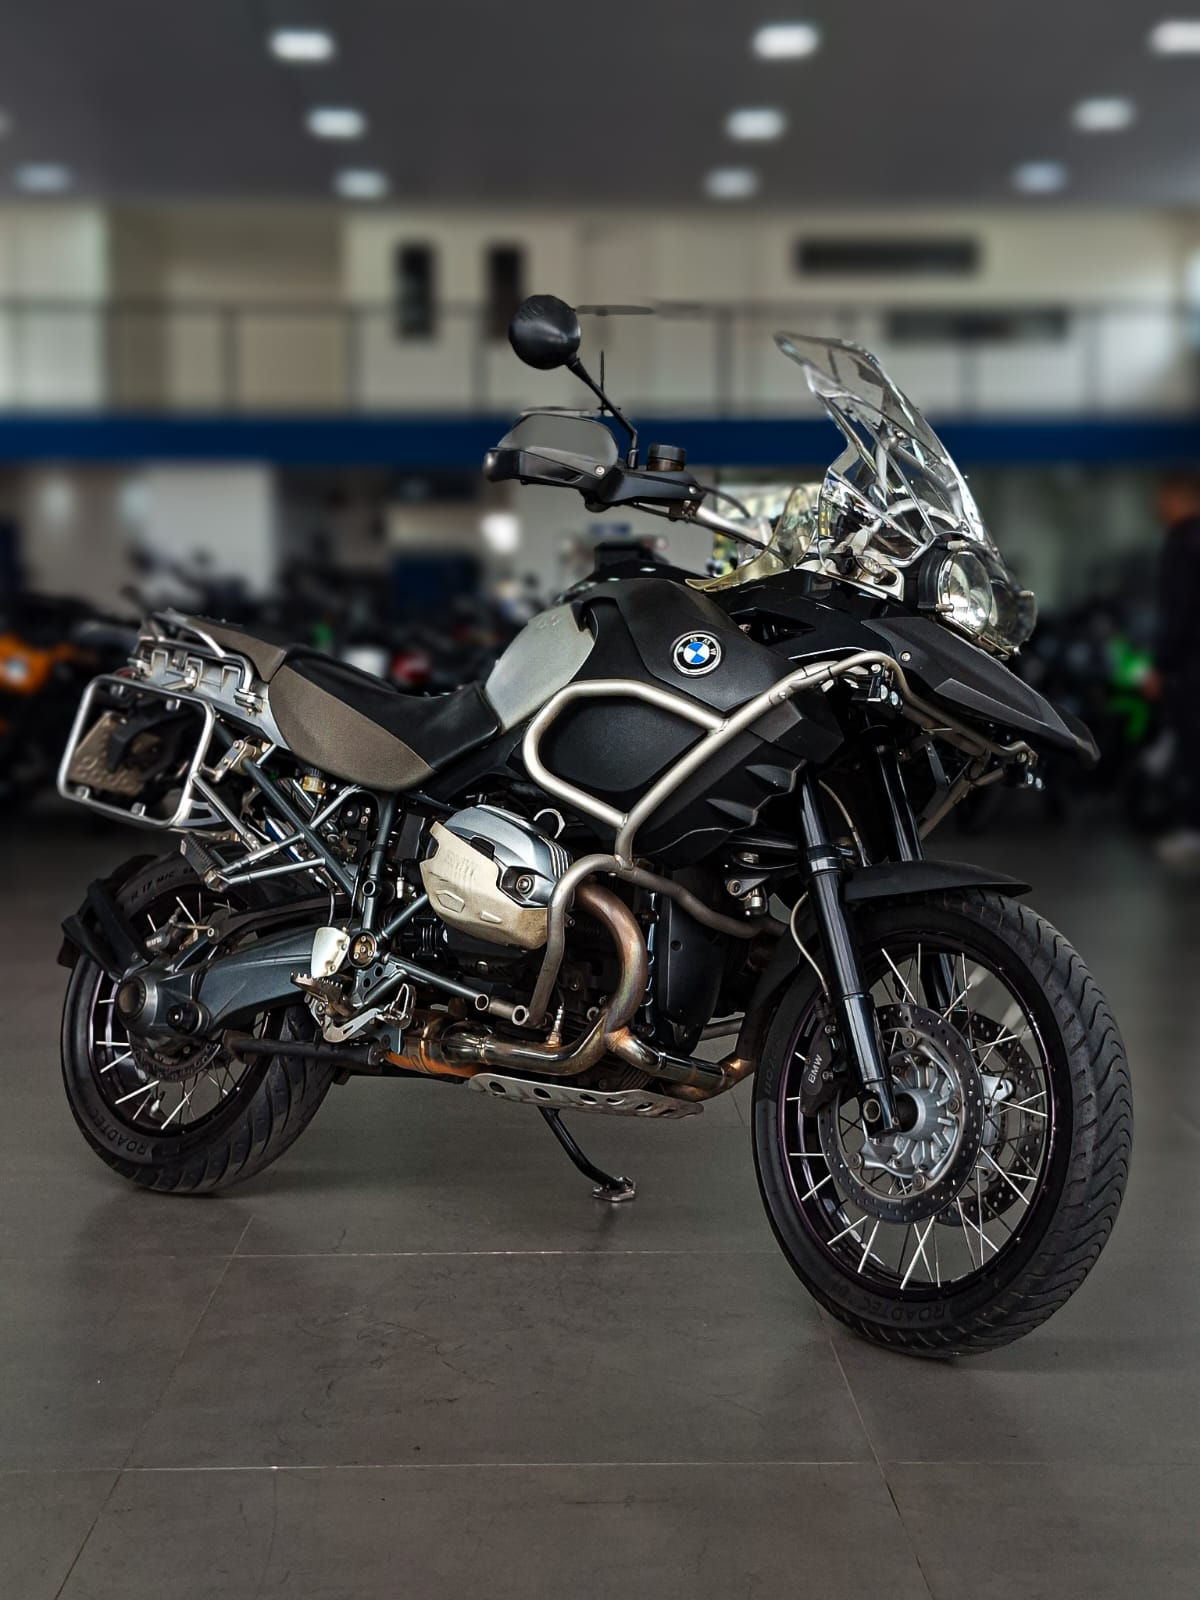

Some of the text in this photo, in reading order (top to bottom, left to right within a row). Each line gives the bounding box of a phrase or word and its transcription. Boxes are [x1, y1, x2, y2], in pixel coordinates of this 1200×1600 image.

[807, 1053, 823, 1084] BMW
[87, 1104, 149, 1156] ROADTEC
[851, 1295, 946, 1321] ROADTEC
